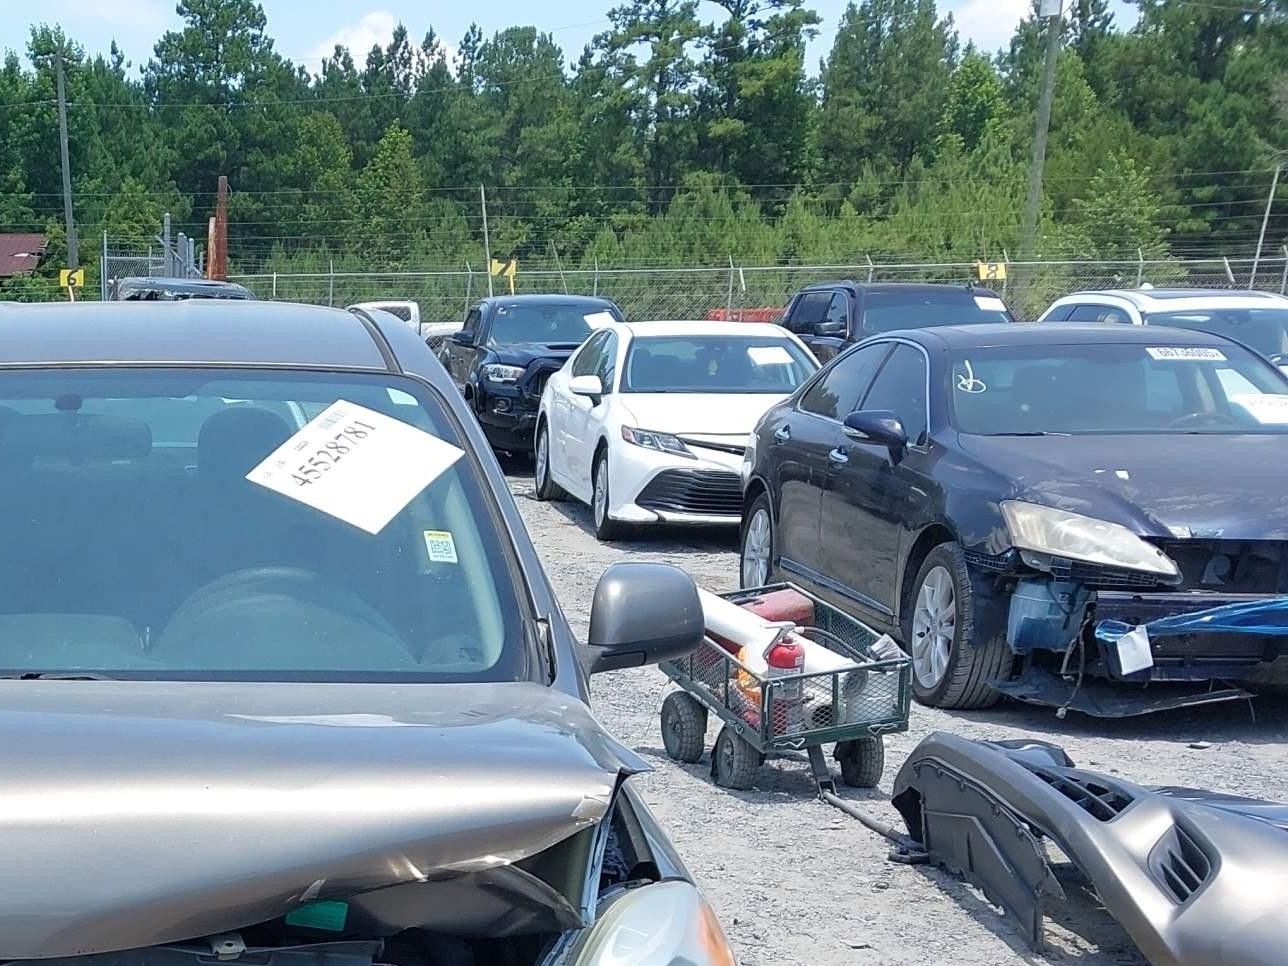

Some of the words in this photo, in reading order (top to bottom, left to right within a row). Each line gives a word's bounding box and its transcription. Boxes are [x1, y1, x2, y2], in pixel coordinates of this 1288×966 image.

[66, 269, 79, 286] 6
[986, 263, 999, 279] 8
[291, 420, 376, 486] 45528781
